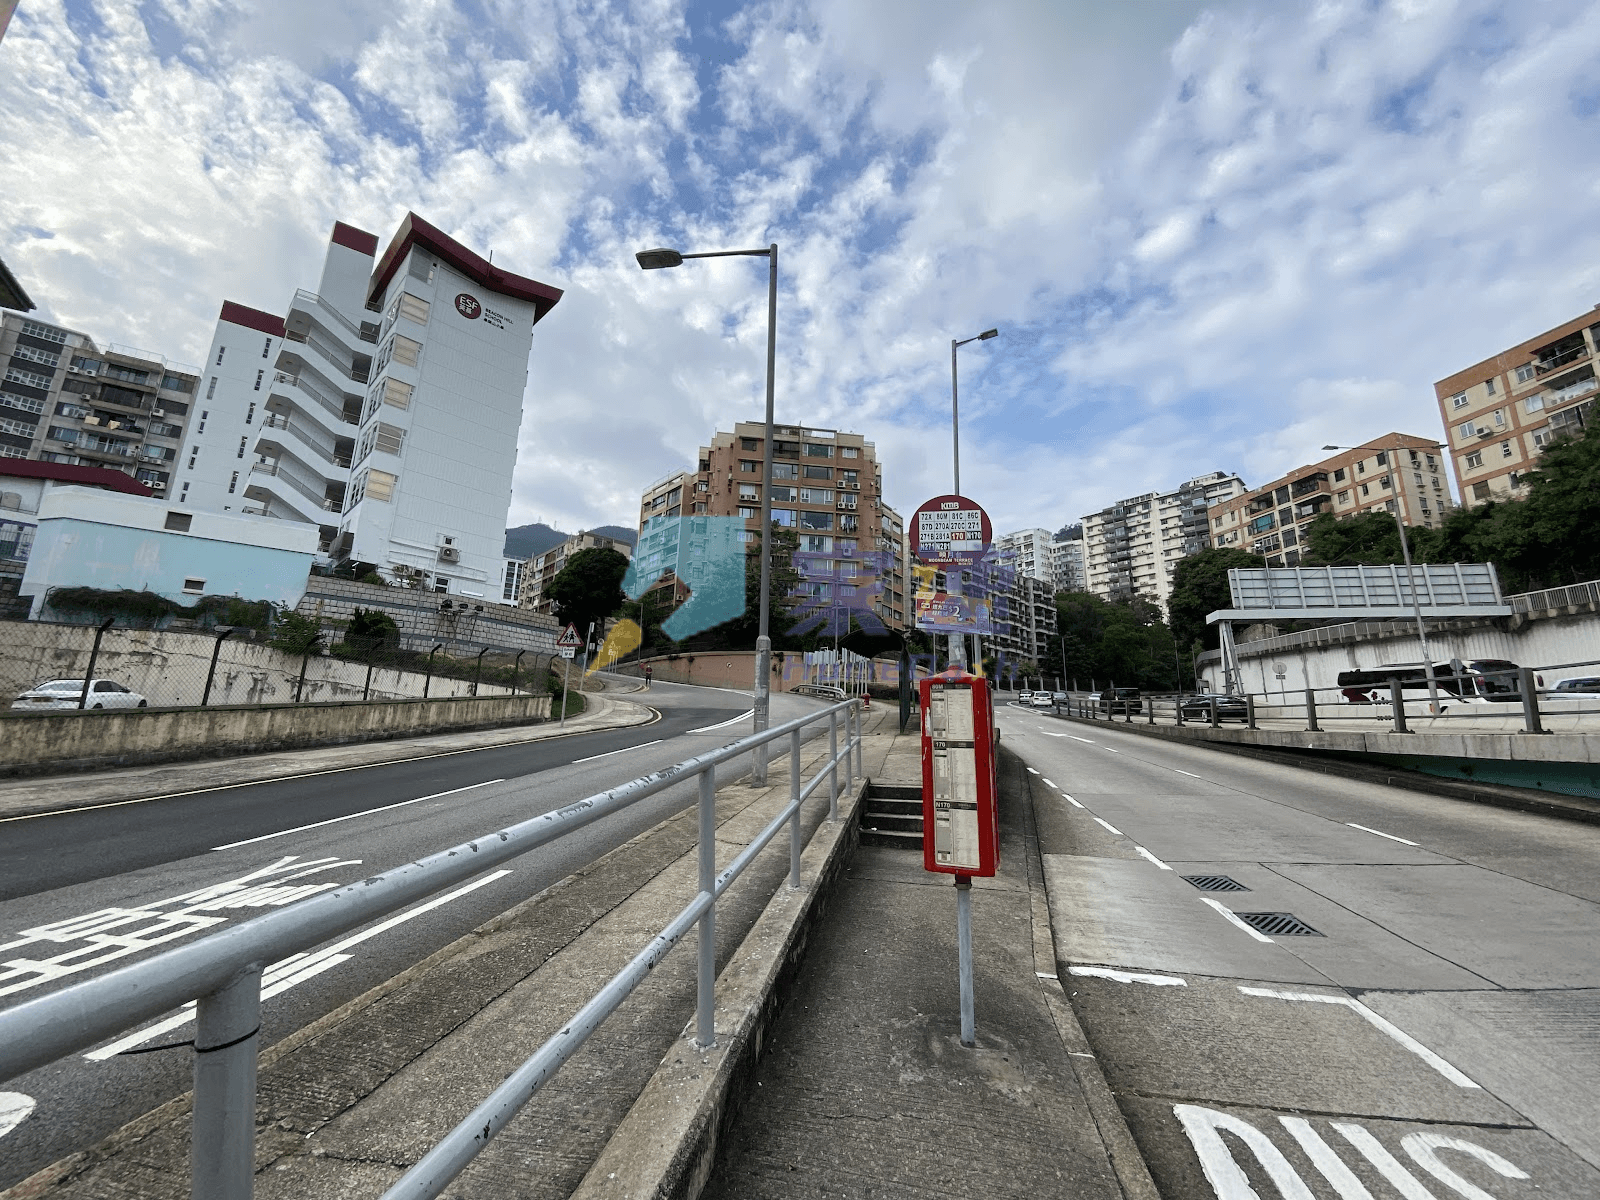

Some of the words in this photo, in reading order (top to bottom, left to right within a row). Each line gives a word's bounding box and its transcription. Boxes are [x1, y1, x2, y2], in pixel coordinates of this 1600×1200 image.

[460, 296, 479, 309] ESF
[951, 512, 963, 520] 81C
[951, 522, 965, 530] 270C
[951, 532, 964, 540] 170
